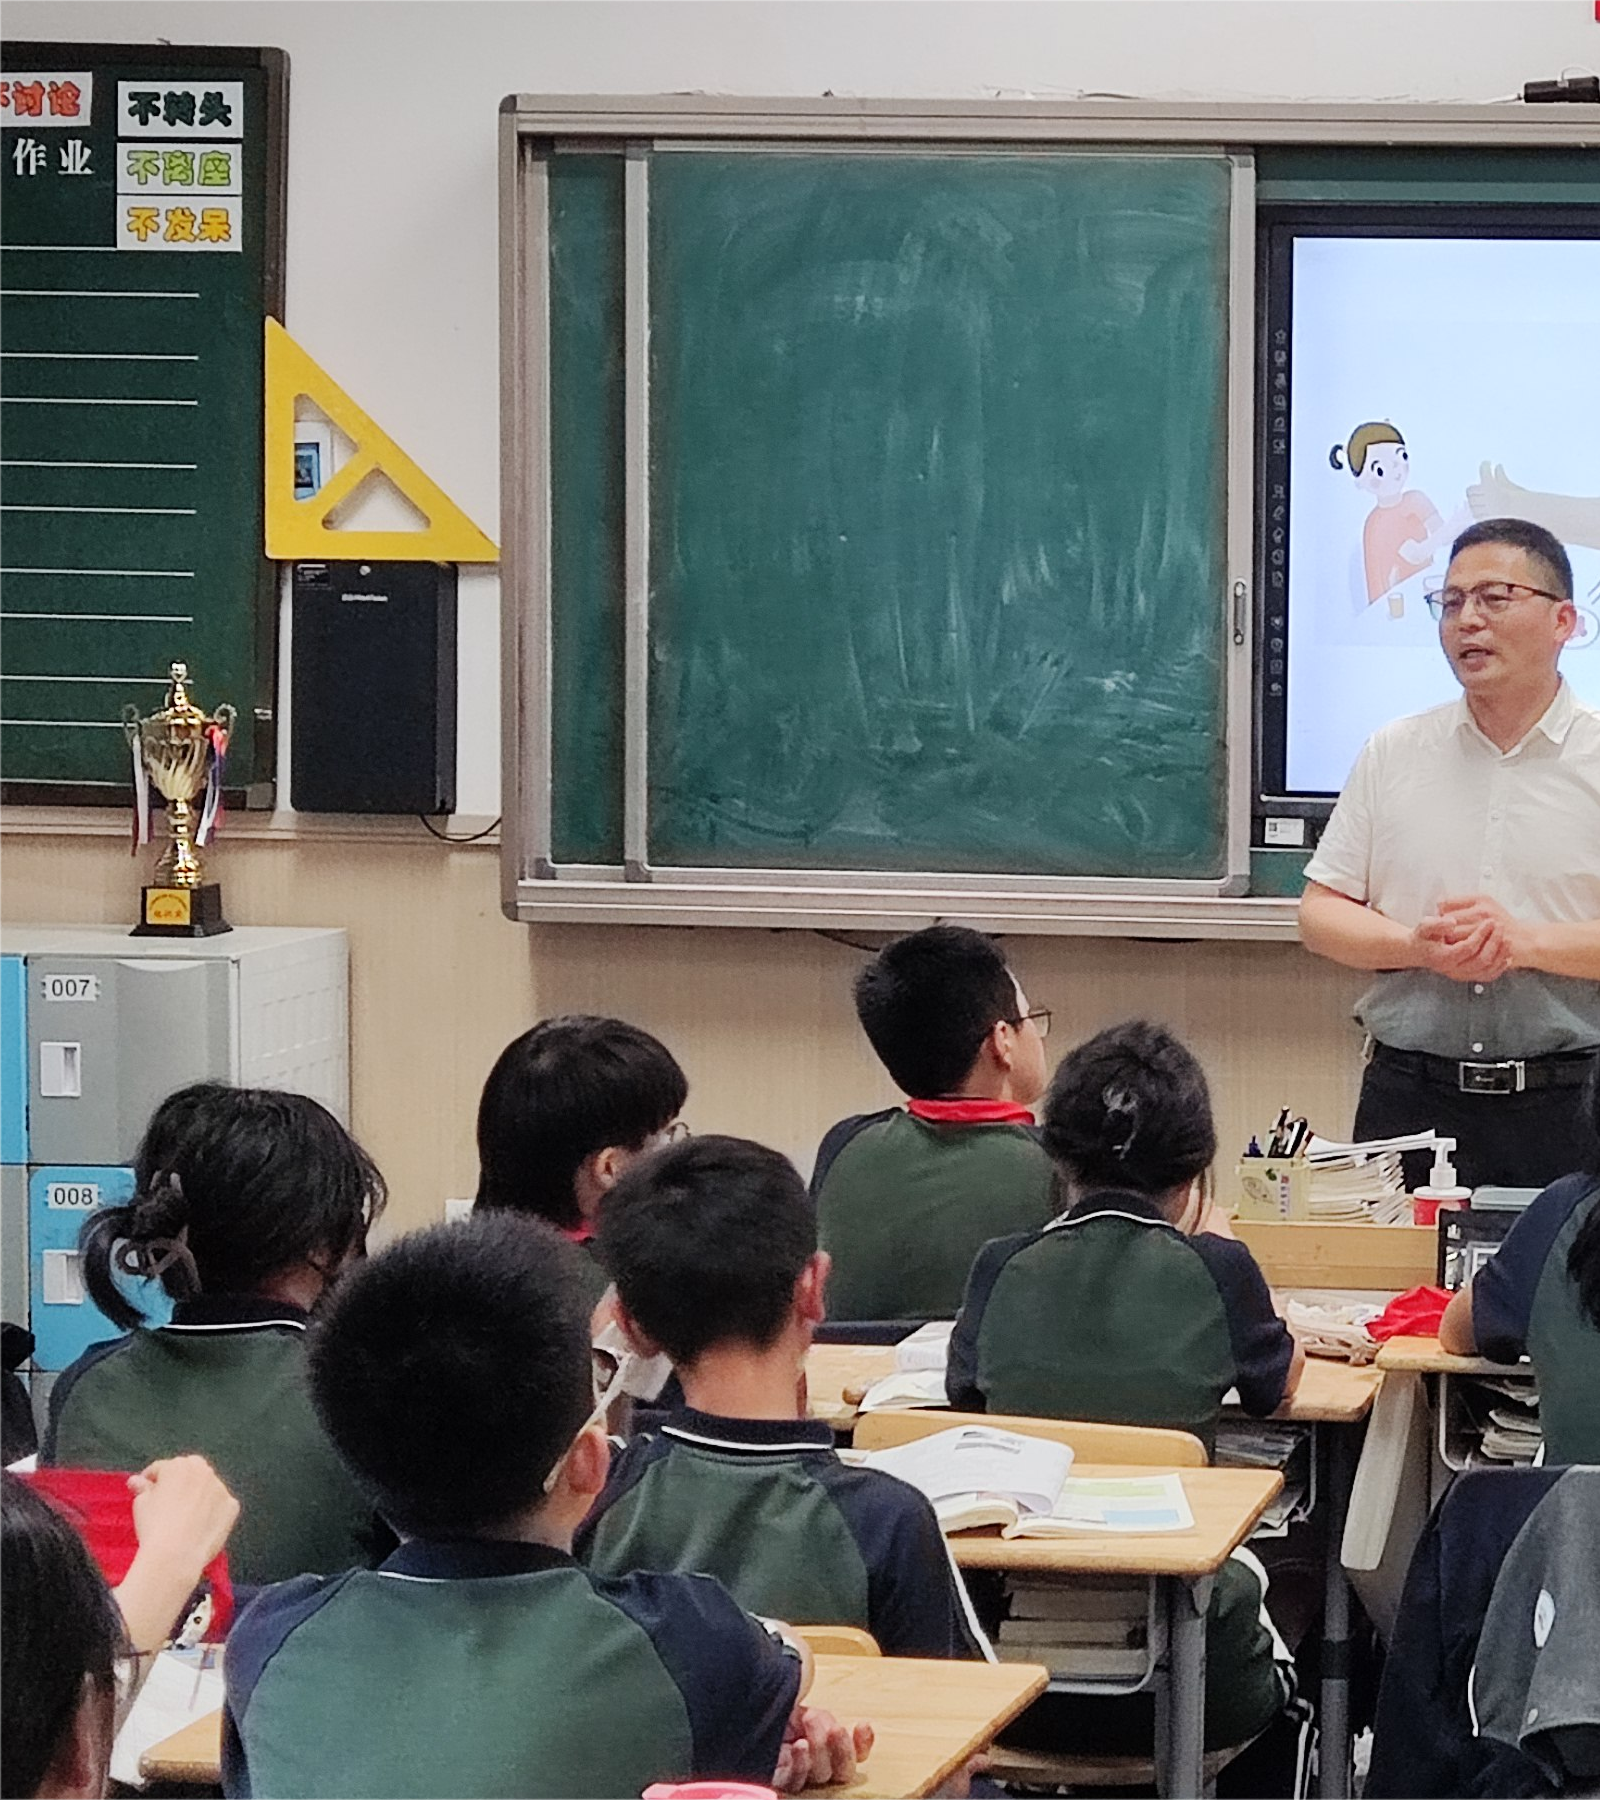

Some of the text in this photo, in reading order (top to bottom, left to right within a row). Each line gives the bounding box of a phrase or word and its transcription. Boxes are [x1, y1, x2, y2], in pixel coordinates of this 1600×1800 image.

[128, 91, 232, 127] 不转头
[12, 137, 95, 176] 作业
[127, 150, 231, 186] 不离座
[127, 207, 231, 243] 不发呆
[52, 979, 90, 997] 007
[54, 1187, 93, 1206] 008
